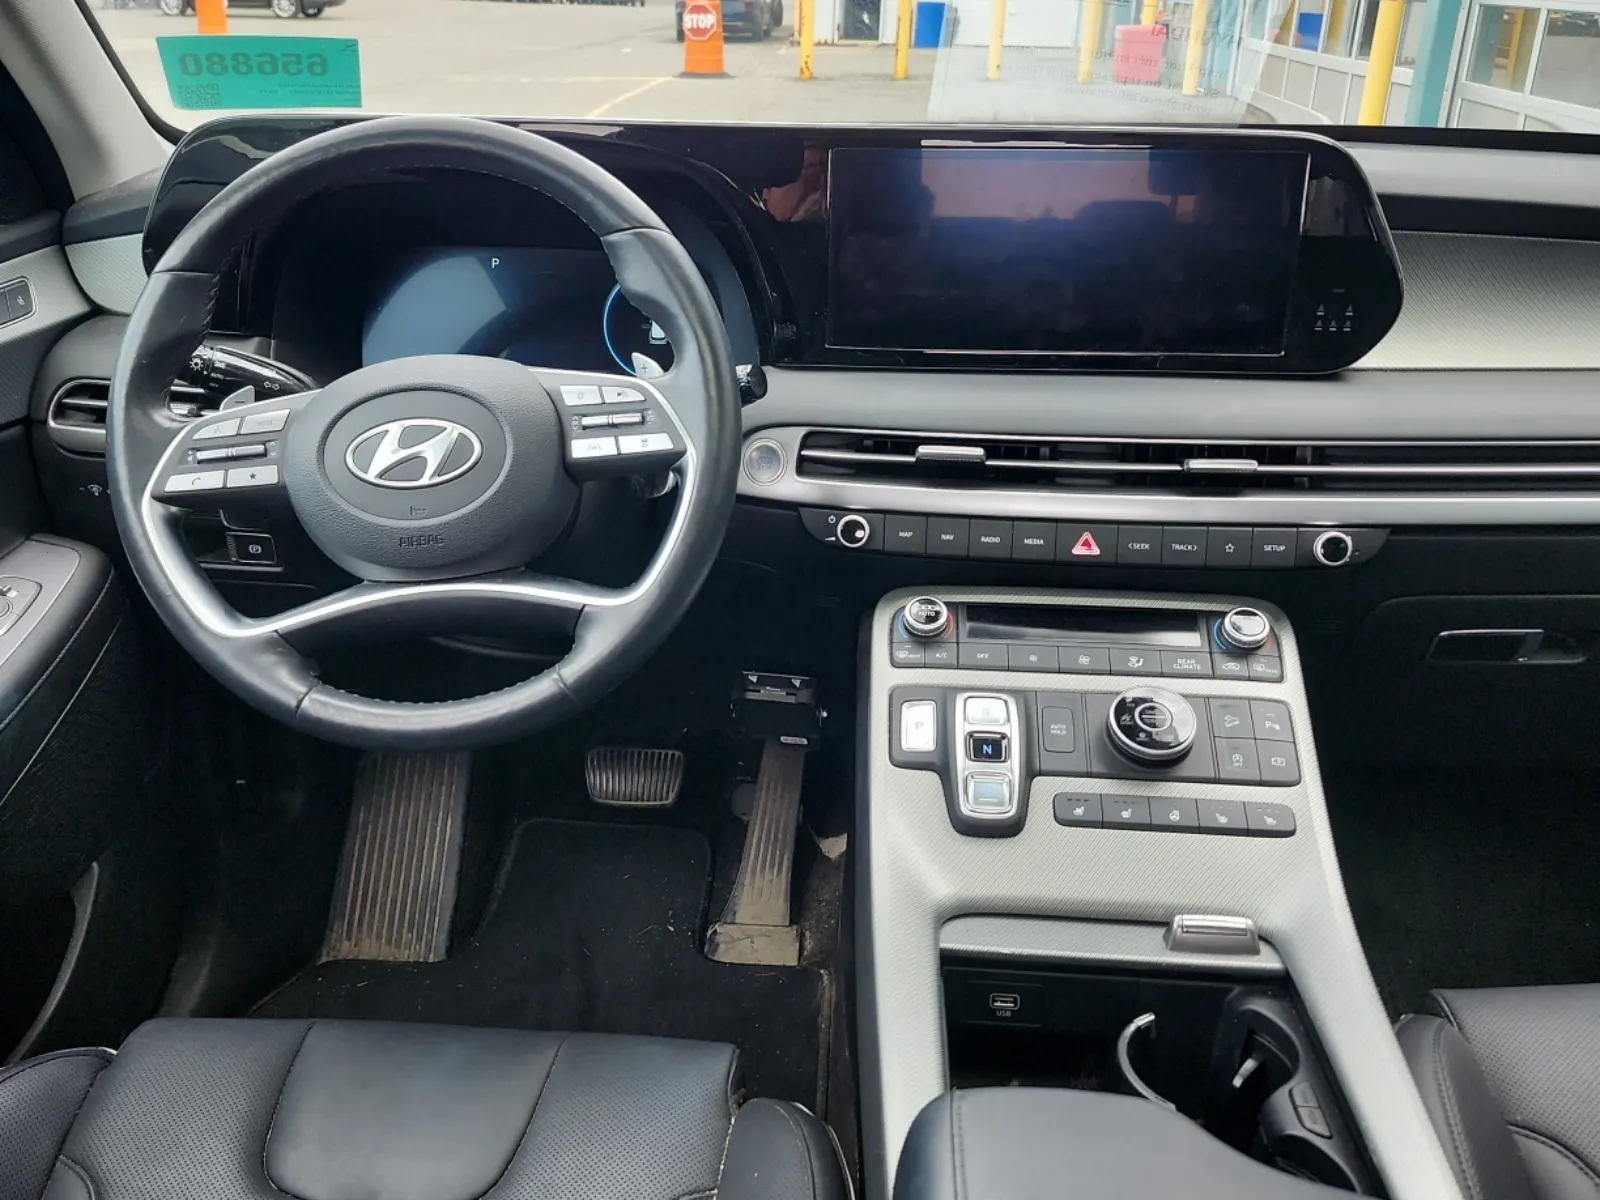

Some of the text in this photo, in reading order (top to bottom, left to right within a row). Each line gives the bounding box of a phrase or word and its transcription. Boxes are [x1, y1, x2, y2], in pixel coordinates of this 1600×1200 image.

[683, 12, 715, 30] STOP
[491, 258, 499, 269] P
[399, 534, 444, 548] AIRBAG
[1263, 544, 1286, 552] SETUP
[1173, 663, 1202, 671] CLIMATE
[982, 708, 991, 717] R
[914, 721, 924, 731] P
[983, 744, 992, 754] N
